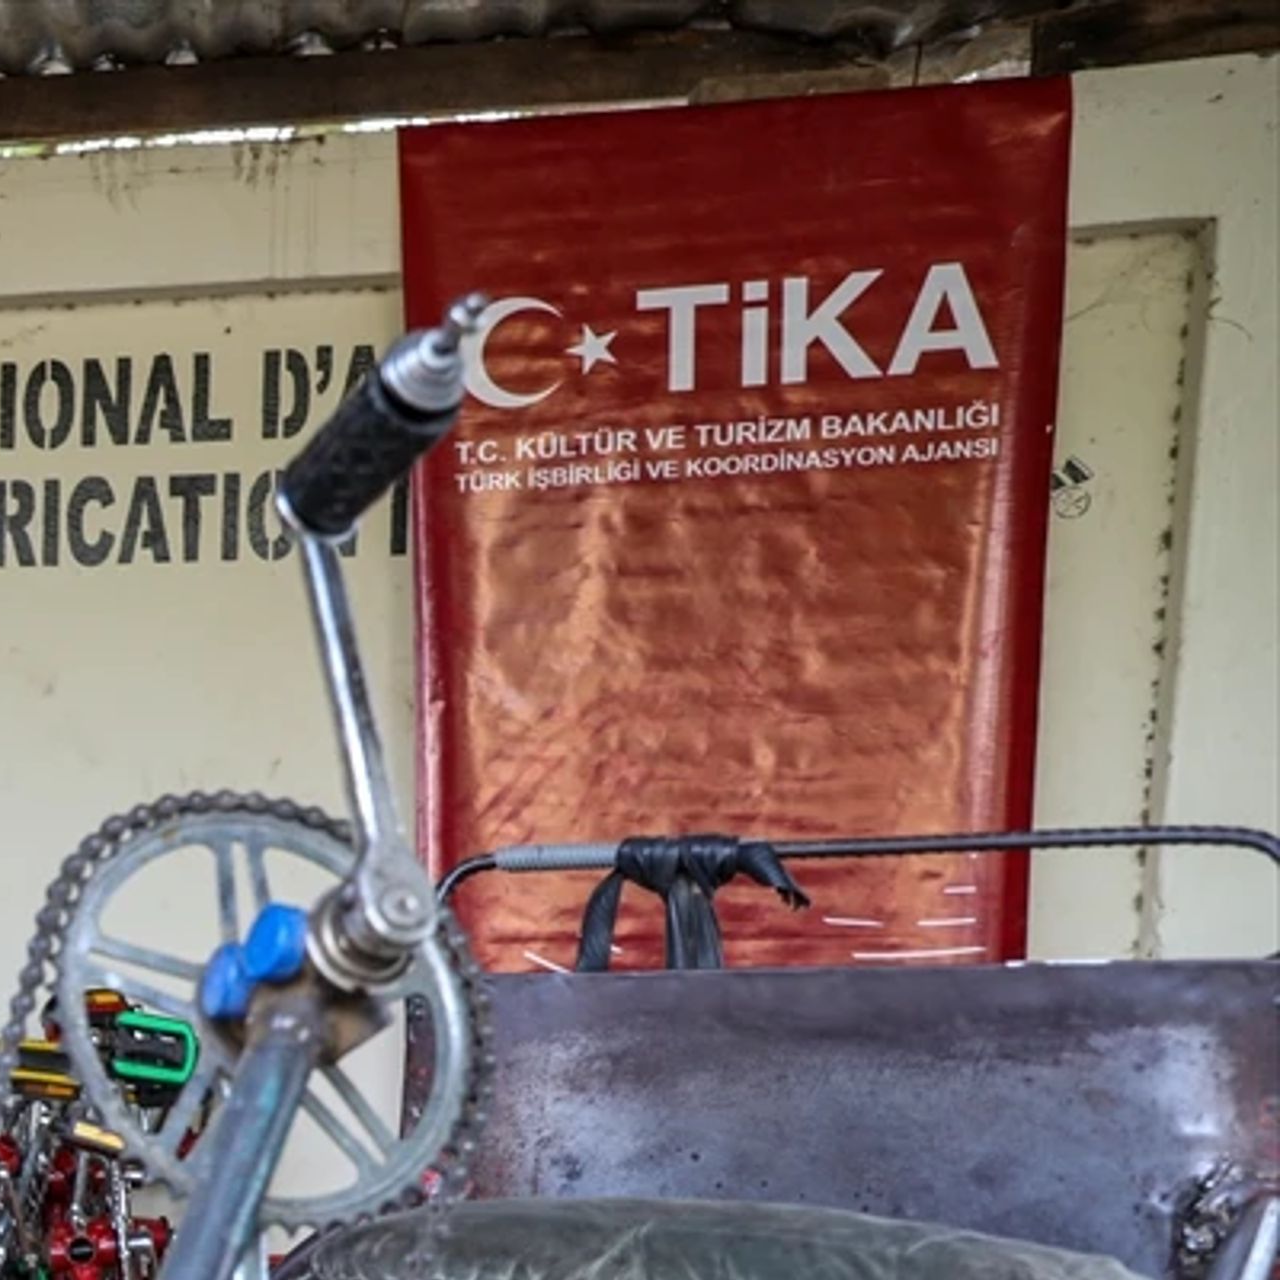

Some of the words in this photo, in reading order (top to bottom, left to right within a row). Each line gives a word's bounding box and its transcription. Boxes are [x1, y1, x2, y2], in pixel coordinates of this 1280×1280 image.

[455, 440, 506, 464] T.C.
[515, 428, 637, 460] KÜLTÜR
[645, 425, 686, 450] VE
[694, 415, 811, 447] TURİZM
[820, 400, 1000, 440] BAKANLIĞI
[455, 469, 521, 492] TÜRK
[646, 459, 679, 480] VE
[686, 445, 895, 477] KOORDİNASYON
[902, 438, 999, 463] AJANSI
